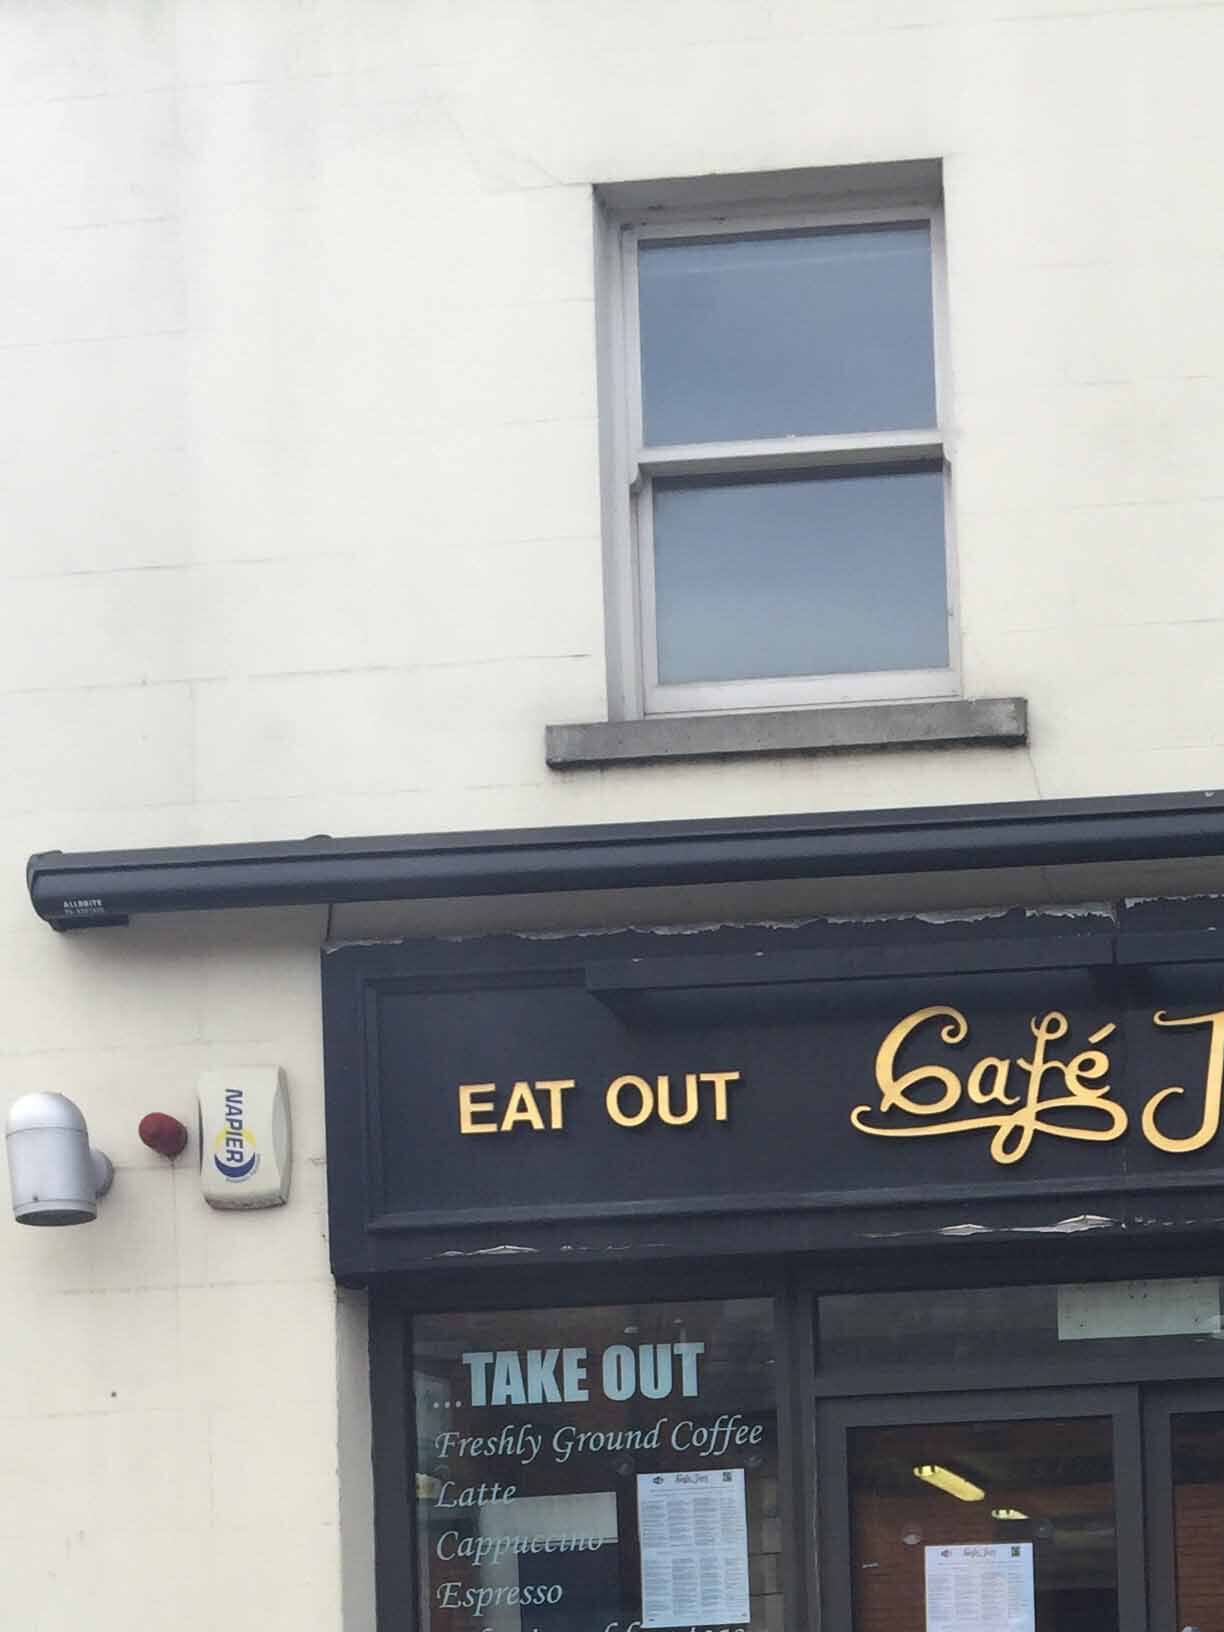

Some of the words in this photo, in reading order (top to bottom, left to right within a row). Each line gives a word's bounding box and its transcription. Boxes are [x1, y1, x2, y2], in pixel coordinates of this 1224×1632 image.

[458, 1079, 576, 1135] EAT
[605, 1071, 741, 1128] OUT
[851, 1005, 1129, 1164] Café
[224, 1088, 244, 1163] NAPIER
[602, 1342, 705, 1401] OUT
[434, 1423, 543, 1465] Freshly
[552, 1418, 669, 1463] Ground
[671, 1414, 764, 1457] Coffee
[433, 1480, 518, 1508] Latte
[436, 1530, 605, 1566] Cappuccino
[436, 1582, 564, 1617] Espresso
